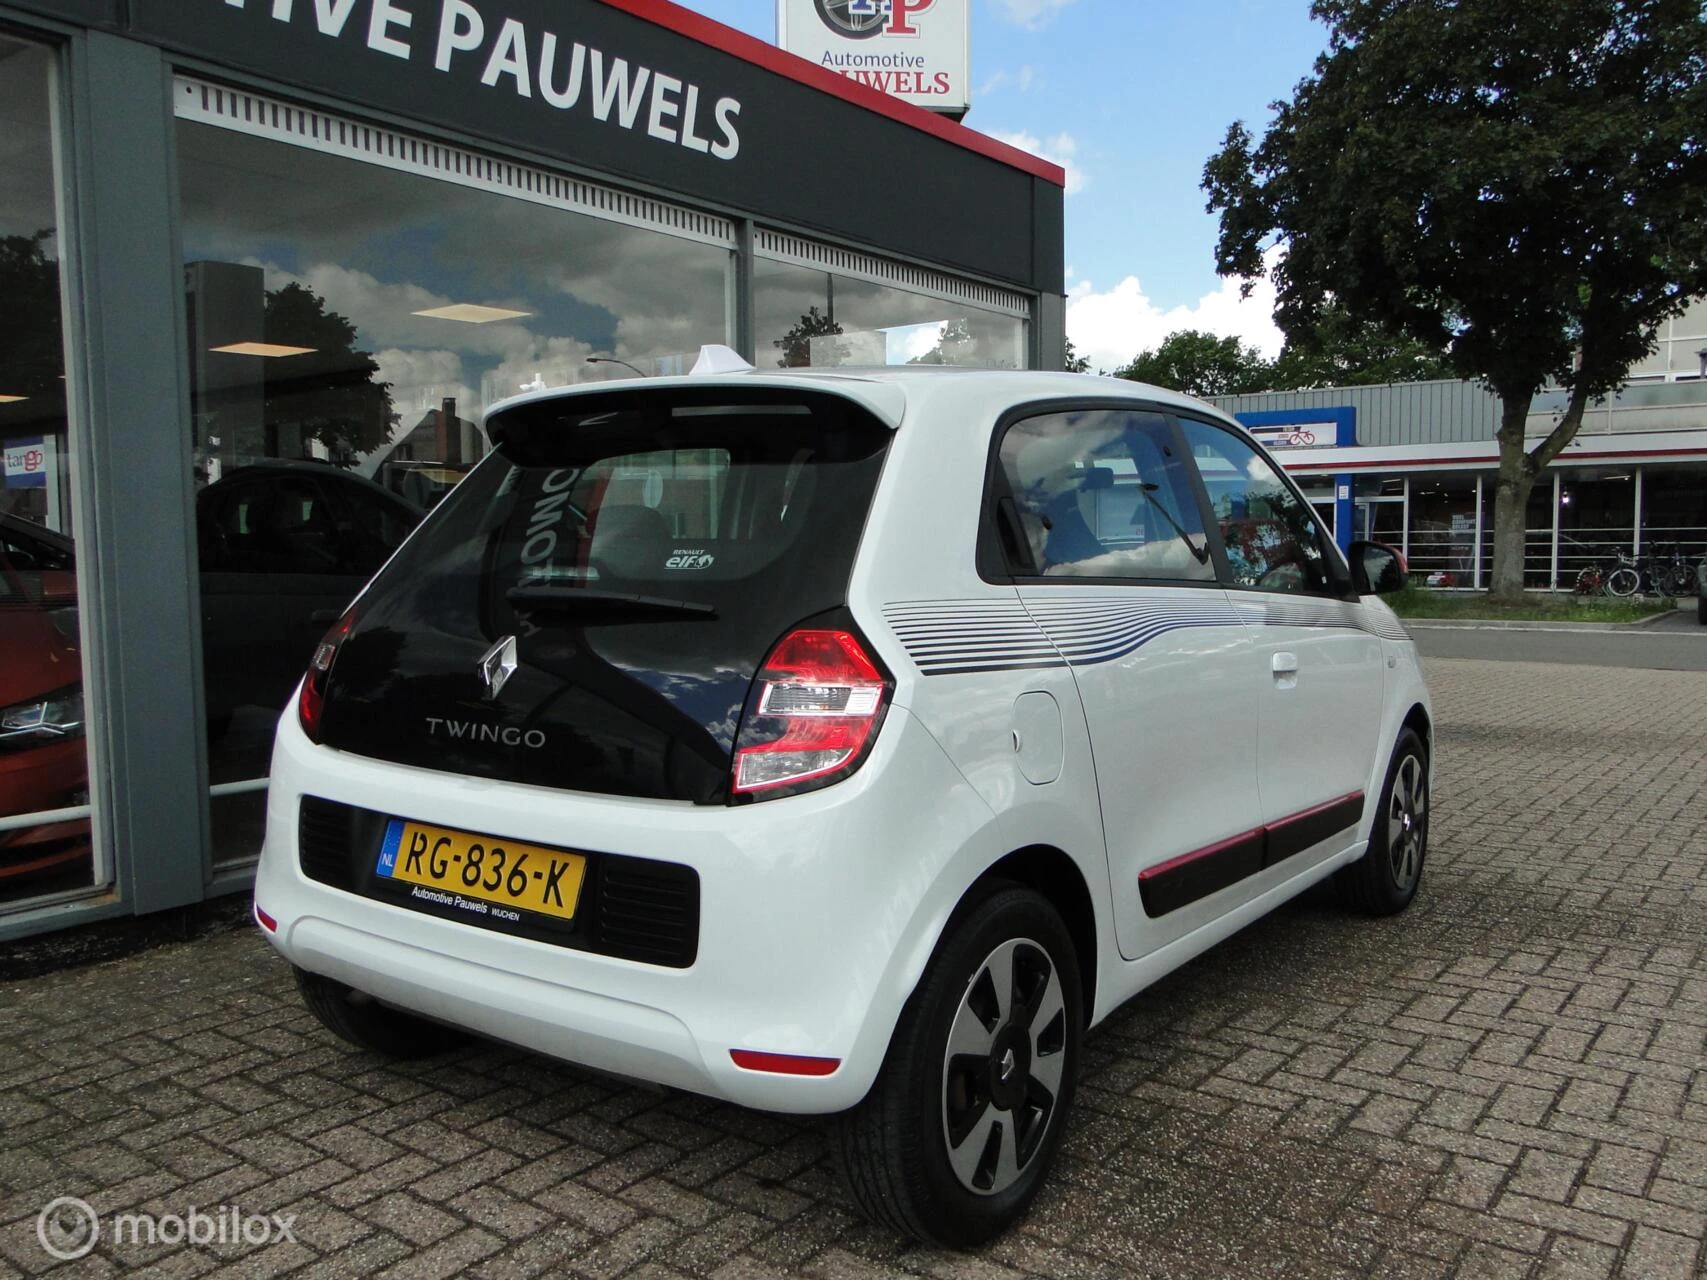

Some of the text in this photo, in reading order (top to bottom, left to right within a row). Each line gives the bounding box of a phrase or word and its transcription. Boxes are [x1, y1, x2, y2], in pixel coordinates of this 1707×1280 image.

[822, 50, 925, 68] Automotive
[434, 0, 741, 160] PAUWELS
[426, 717, 546, 748] TWINGO
[381, 852, 393, 867] NL
[405, 831, 570, 908] RG-836-K
[411, 886, 453, 905] Automotive
[454, 896, 488, 914] Pauwels
